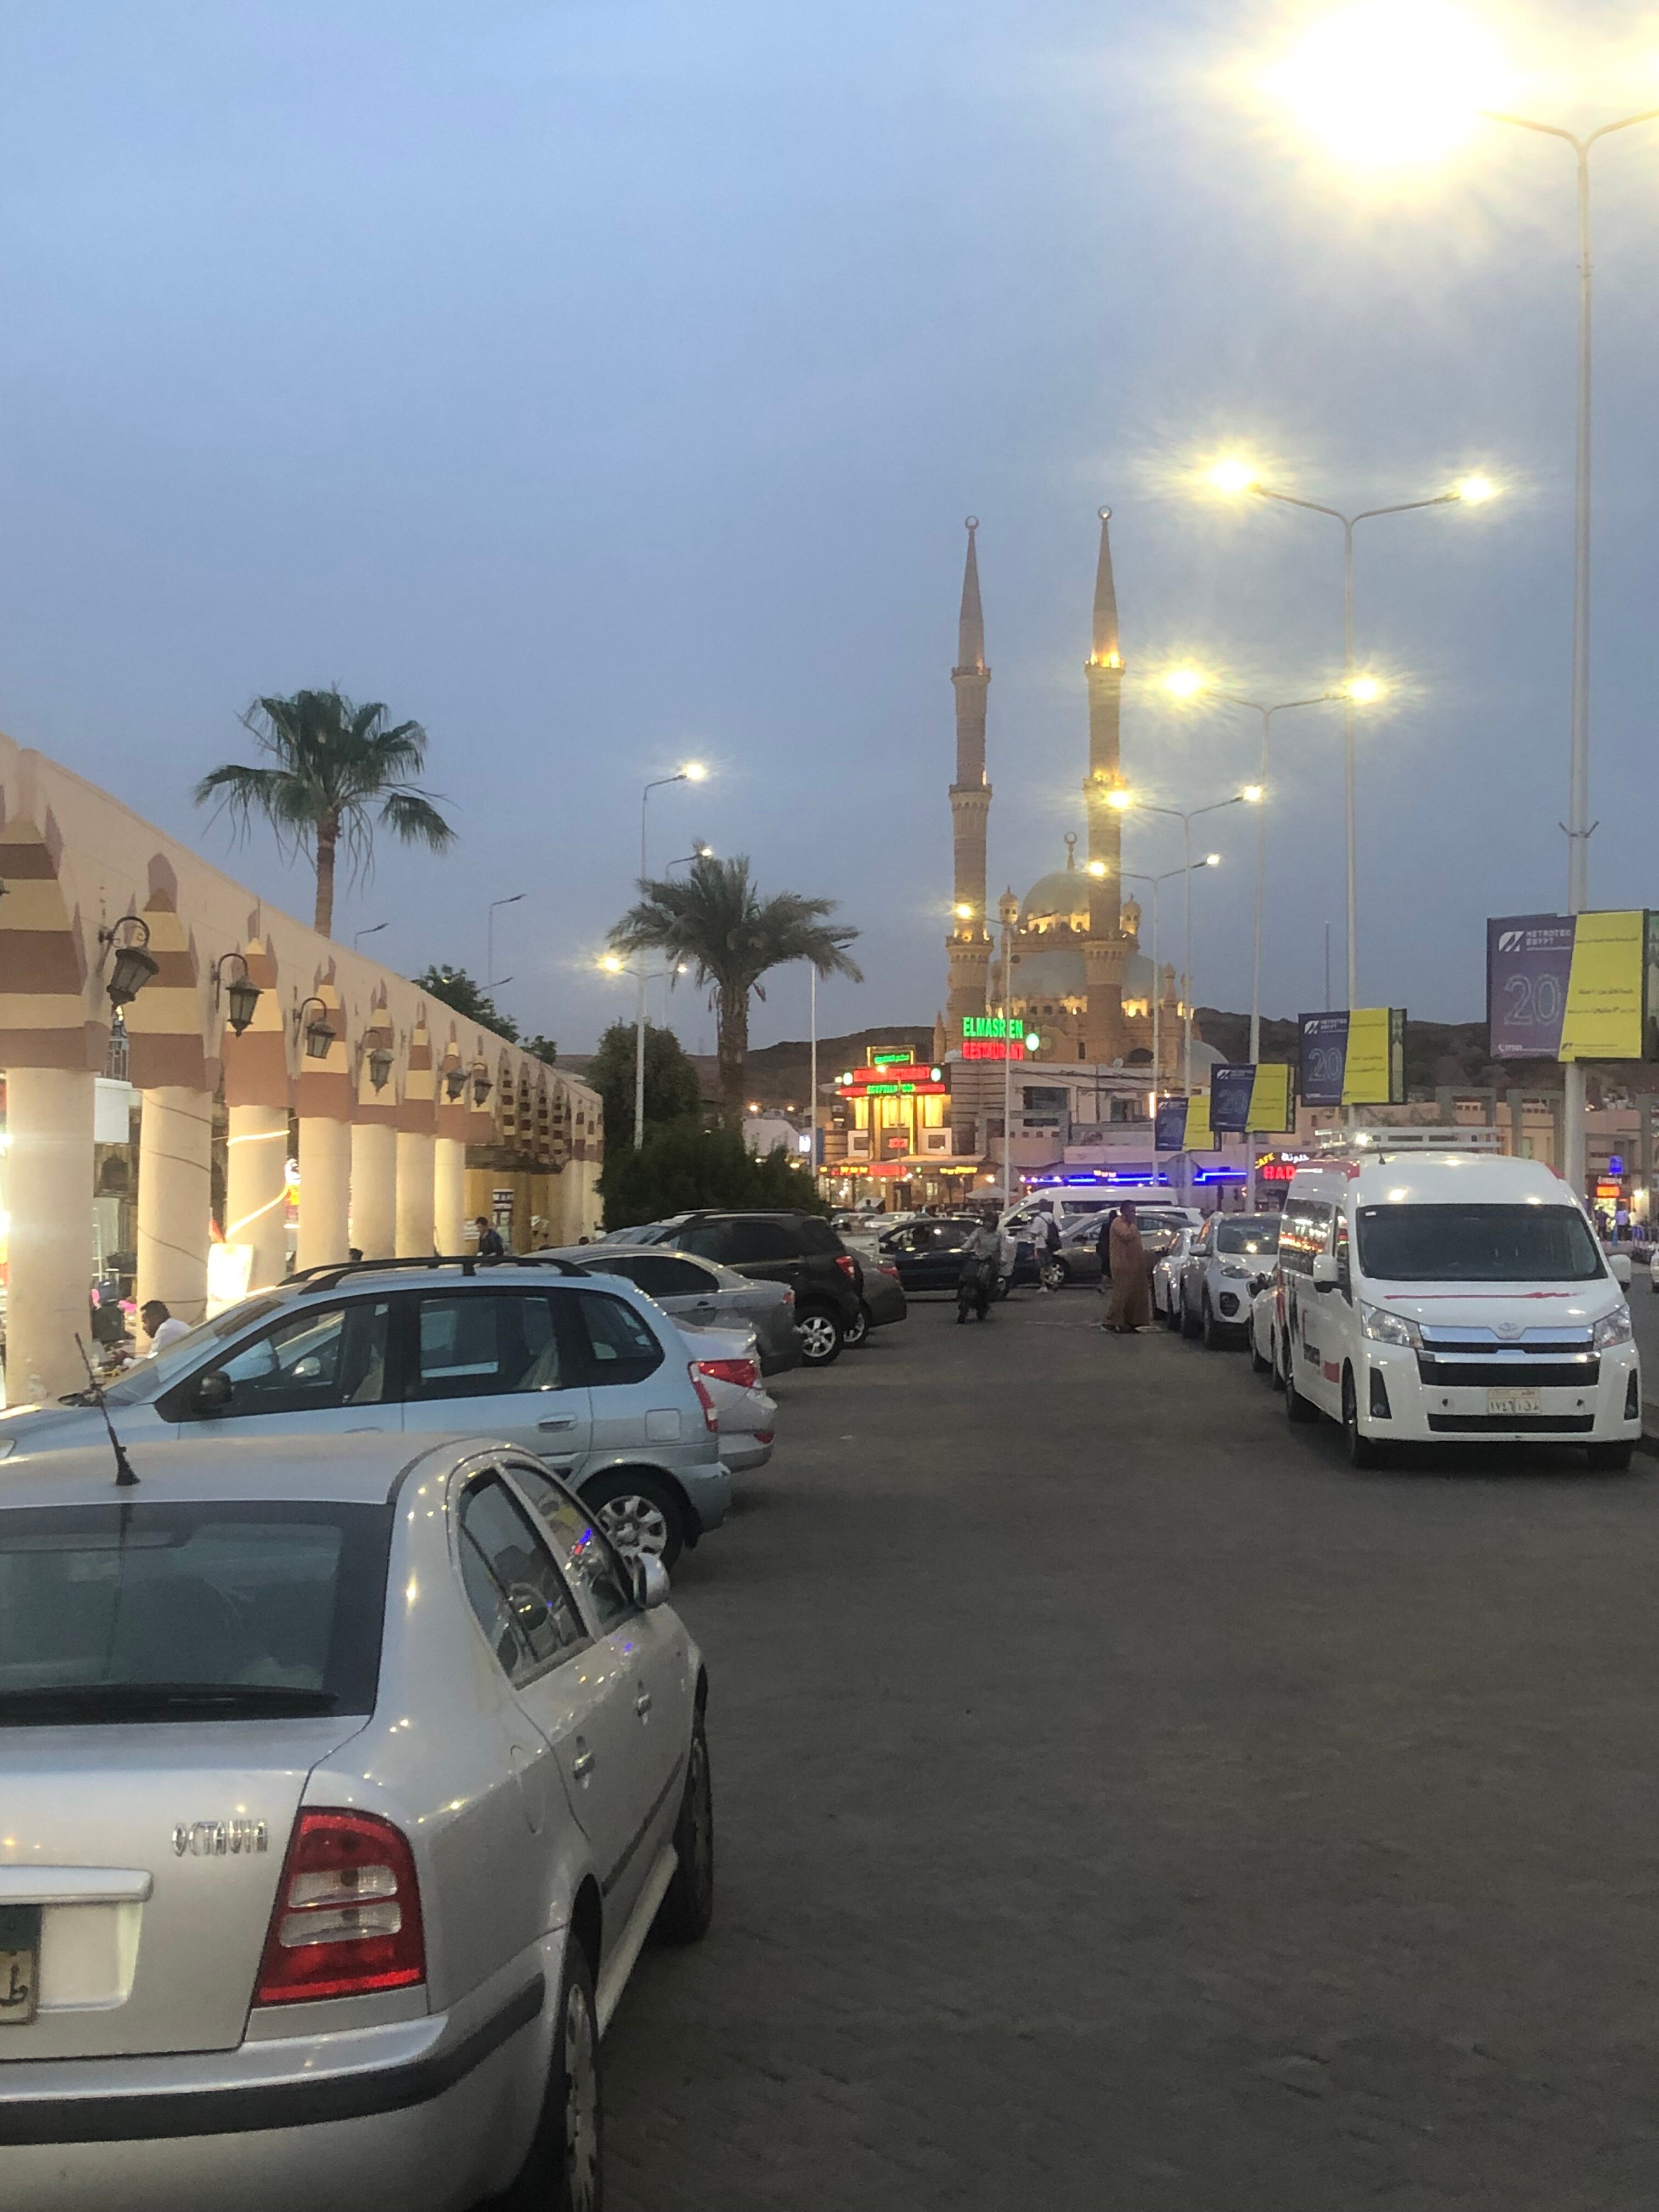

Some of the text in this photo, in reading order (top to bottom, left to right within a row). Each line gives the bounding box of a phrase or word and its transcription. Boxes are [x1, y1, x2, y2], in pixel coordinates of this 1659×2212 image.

[1504, 973, 1561, 1025] 20
[963, 1017, 1023, 1039] ELMASREN
[1308, 1048, 1342, 1082] 20
[172, 1818, 268, 1857] OCTAVIA
